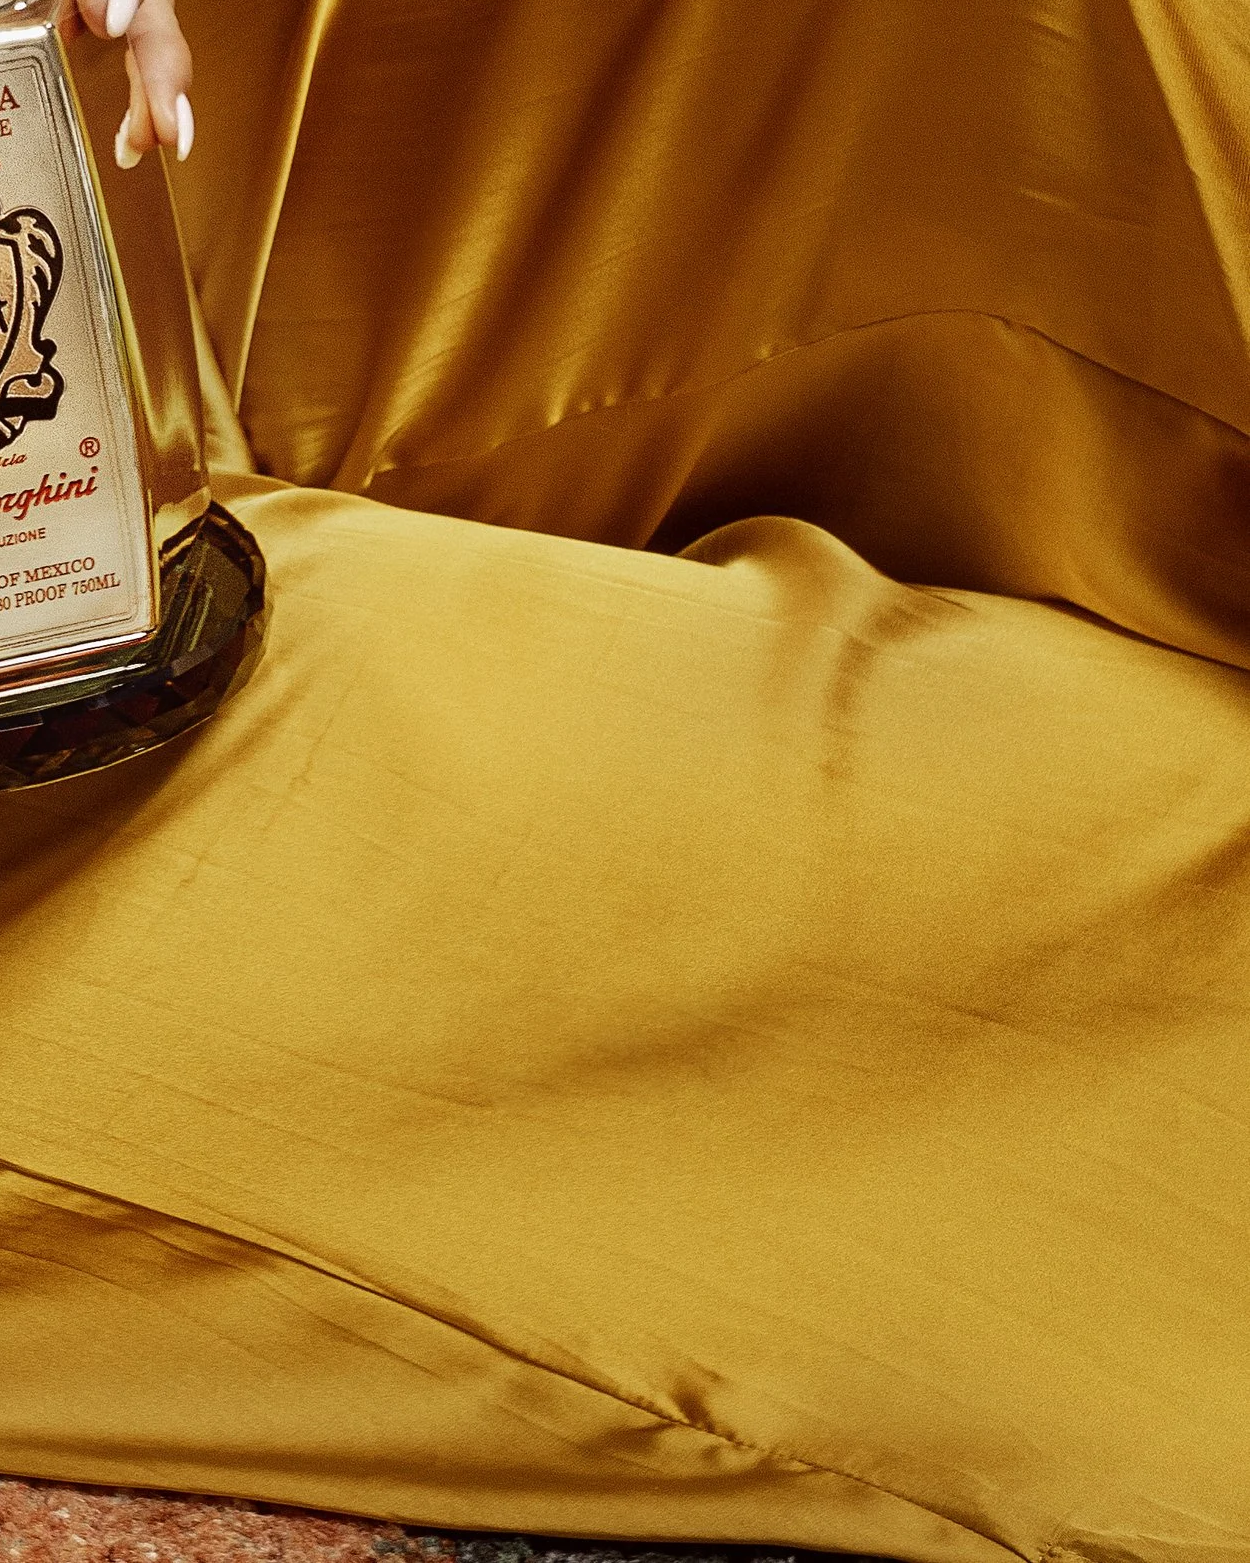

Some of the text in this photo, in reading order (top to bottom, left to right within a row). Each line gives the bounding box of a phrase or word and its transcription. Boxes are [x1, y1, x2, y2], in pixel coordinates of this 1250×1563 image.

[24, 556, 95, 584] MEXICO
[14, 583, 67, 608] PROOF
[72, 572, 121, 596] 750ML
